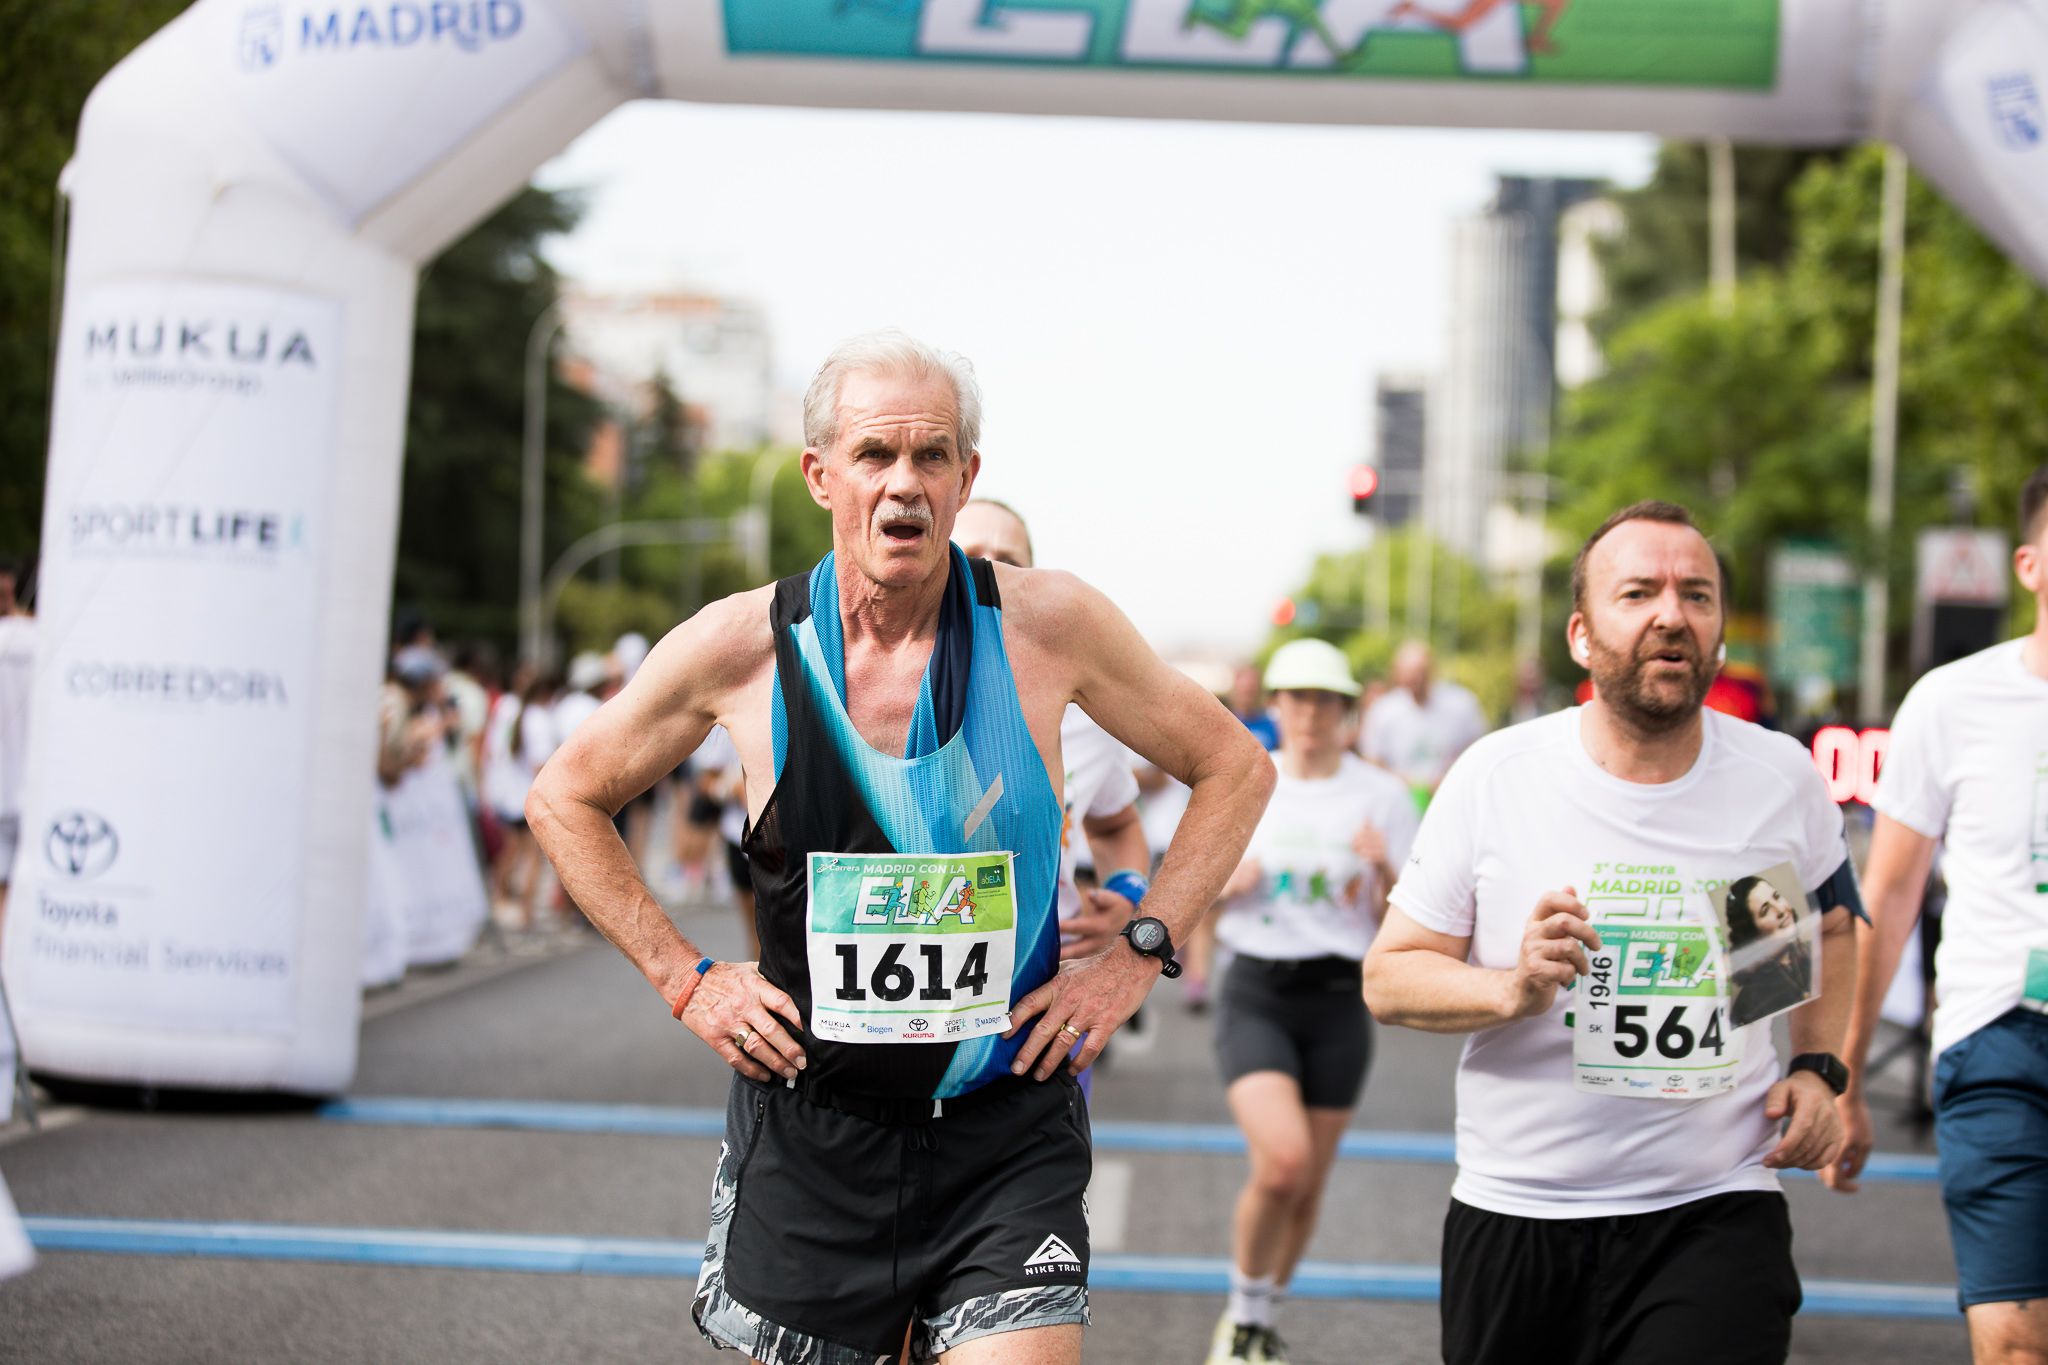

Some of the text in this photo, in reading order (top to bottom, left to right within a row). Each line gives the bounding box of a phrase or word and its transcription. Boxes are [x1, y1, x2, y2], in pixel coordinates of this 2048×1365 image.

[300, 0, 524, 53] MADRID
[86, 318, 317, 371] MUKUA
[829, 864, 860, 872] Carrera
[863, 864, 915, 874] MADRID
[919, 864, 946, 874] CON
[950, 864, 965, 874] LA
[1615, 863, 1677, 875] Carrera
[852, 876, 975, 925] ELA
[1589, 879, 1682, 894] MADRID
[37, 889, 119, 930] Toyota
[1631, 930, 1678, 940] MADRID
[161, 937, 289, 978] Services
[835, 941, 988, 1001] 1614
[1620, 942, 1720, 988] ELA
[1589, 956, 1612, 1010] 1946
[821, 1019, 850, 1028] MUKUA
[867, 1025, 893, 1034] Biogen
[947, 1025, 960, 1033] LIFE
[1589, 1024, 1603, 1033] 5K
[1614, 1005, 1725, 1059] 564
[1025, 1265, 1055, 1275] NIKE
